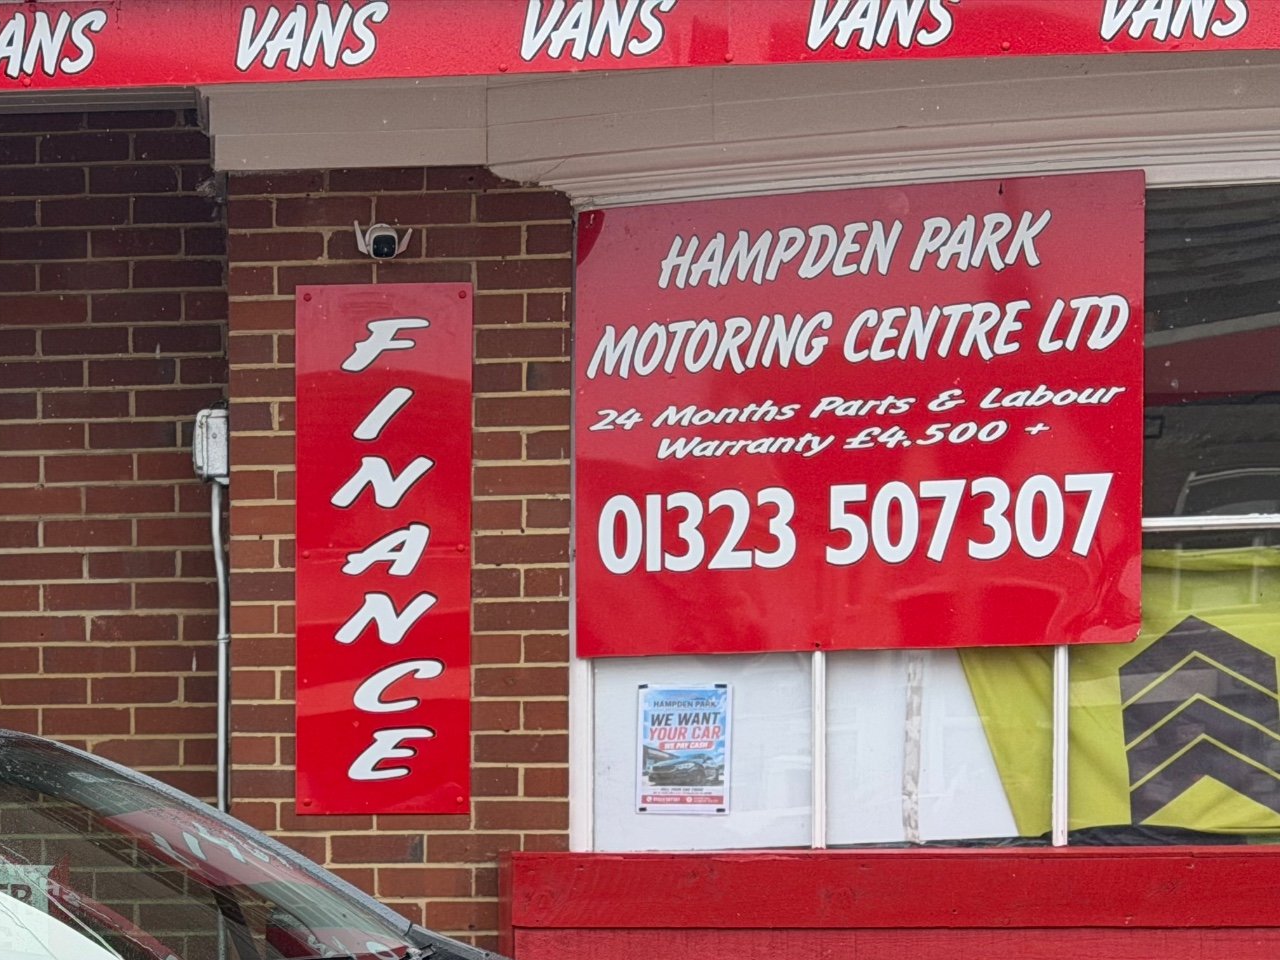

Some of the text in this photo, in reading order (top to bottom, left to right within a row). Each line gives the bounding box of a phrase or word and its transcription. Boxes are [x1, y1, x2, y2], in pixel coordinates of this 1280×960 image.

[235, 0, 390, 72] VANS
[519, 0, 676, 62] VANS
[806, 0, 959, 52] VANS
[1099, 0, 1249, 42] VANS
[658, 209, 1052, 290] HAMPDEN PARK
[586, 294, 1130, 379] MOTORING CENTRE LTD
[588, 384, 1127, 432] 24 Months Parts & Labour
[656, 431, 836, 460] Warranty
[1024, 421, 1051, 436] +
[330, 317, 445, 781] FINANCE
[597, 472, 1114, 575] 01323 507307
[649, 725, 721, 741] YOUR CAR
[651, 712, 720, 726] WE WANT
